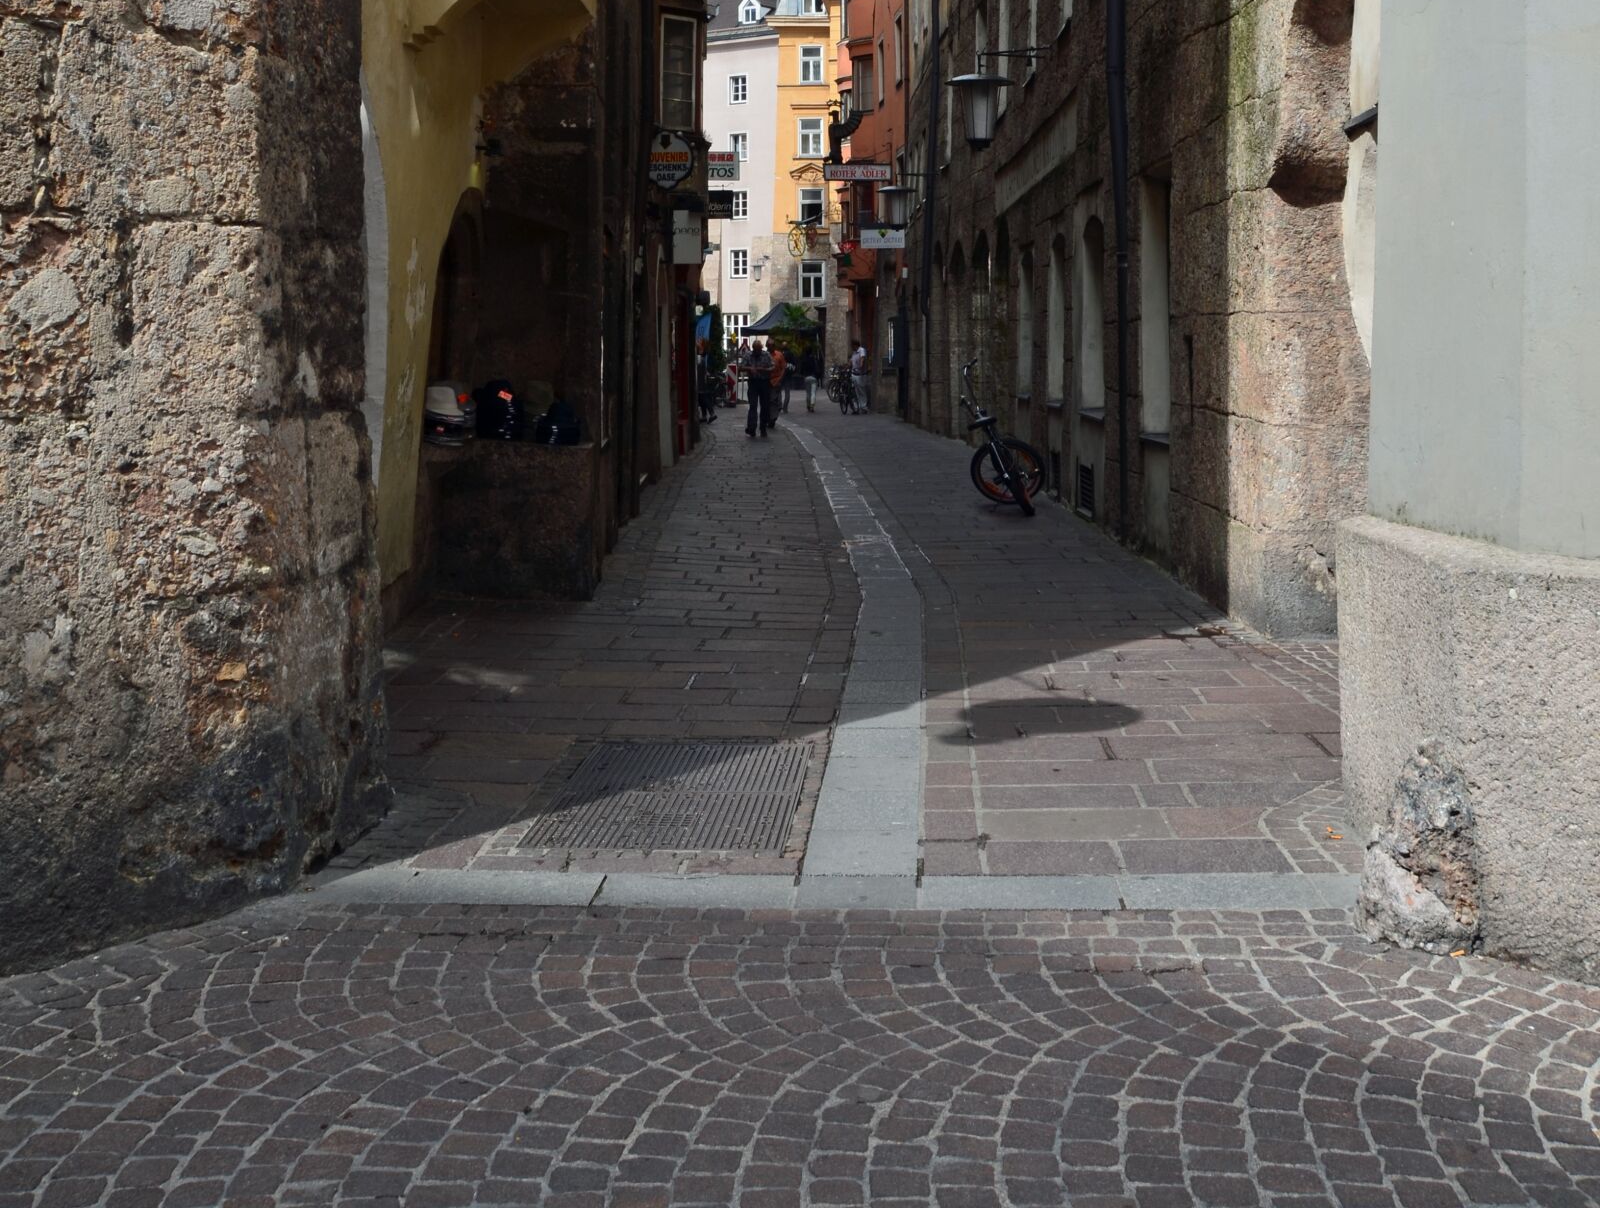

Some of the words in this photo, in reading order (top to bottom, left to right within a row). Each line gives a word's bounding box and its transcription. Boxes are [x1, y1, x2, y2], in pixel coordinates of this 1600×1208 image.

[649, 152, 689, 163] OUVENIRS
[656, 173, 676, 181] OASE
[708, 167, 734, 178] TOS
[830, 170, 857, 178] ROTER
[860, 170, 887, 178] ADLER
